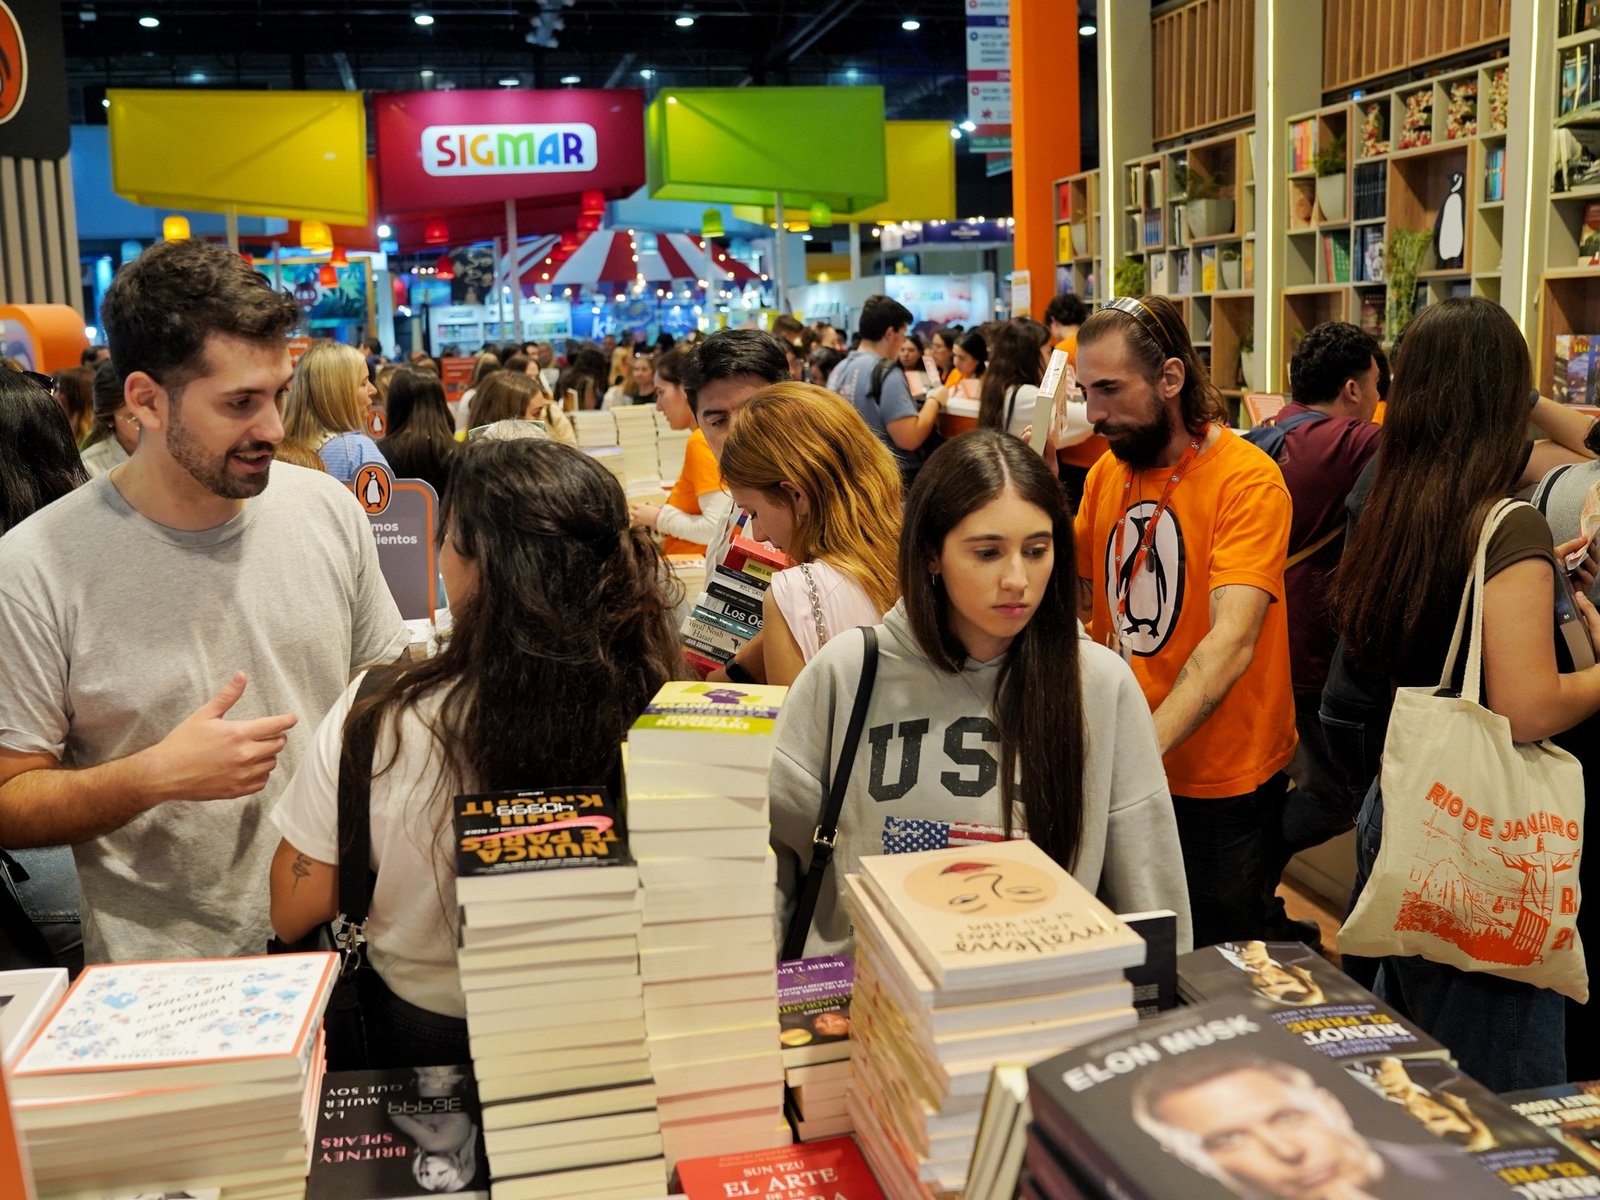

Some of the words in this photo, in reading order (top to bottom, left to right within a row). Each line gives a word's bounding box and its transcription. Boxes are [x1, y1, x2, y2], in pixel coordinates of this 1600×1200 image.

[436, 132, 585, 167] SIGMAR
[724, 603, 746, 621] Los
[748, 610, 763, 628] Oe
[688, 618, 706, 633] Yuval
[707, 626, 724, 638] Noah
[692, 629, 713, 643] Harari
[868, 716, 1012, 802] US
[496, 802, 574, 816] 40999
[1425, 781, 1464, 817] RIO
[1462, 807, 1495, 840] DE
[1498, 811, 1580, 841] JANEIRO
[460, 830, 572, 852] PARES
[580, 828, 619, 842] TE
[476, 841, 609, 863] NUNCA
[807, 961, 845, 971] ROBERT
[1284, 1015, 1361, 1033] PRIME
[1361, 1014, 1393, 1024] EL
[1301, 1023, 1411, 1046] MENOT
[1061, 1042, 1162, 1093] ELON
[1158, 1013, 1261, 1055] MUSK
[326, 1087, 359, 1096] SOY
[366, 1084, 403, 1094] QUE
[325, 1096, 380, 1108] MUJER
[387, 1096, 462, 1115] 36999
[323, 1110, 345, 1120] LA
[320, 1133, 393, 1149] SPEARS
[320, 1145, 407, 1163] BRITNEY
[743, 1167, 774, 1177] SUN
[775, 1160, 804, 1173] TZU
[723, 1180, 760, 1198] EL
[768, 1167, 838, 1192] ARTE
[789, 1189, 805, 1198] LA
